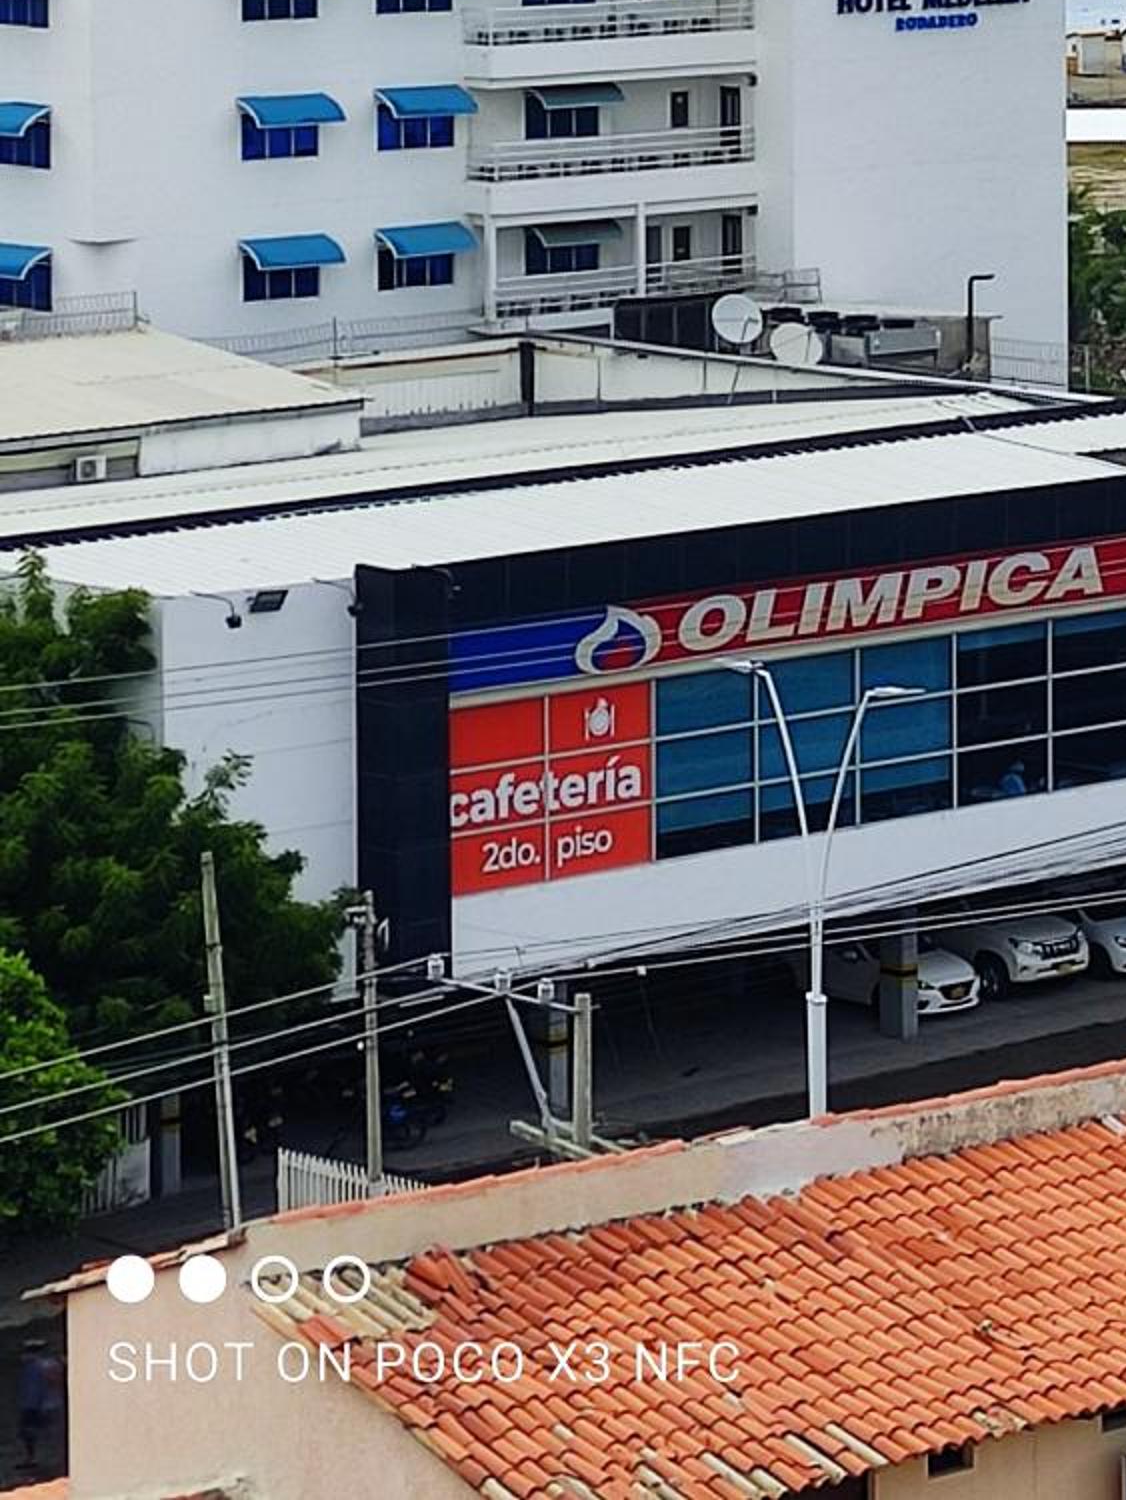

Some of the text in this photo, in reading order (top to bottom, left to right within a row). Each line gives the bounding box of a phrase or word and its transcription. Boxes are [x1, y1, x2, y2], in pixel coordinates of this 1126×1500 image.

[677, 544, 1103, 652] OLIMPICA
[451, 756, 641, 827] cafetería
[482, 825, 613, 872] 2do. piso
